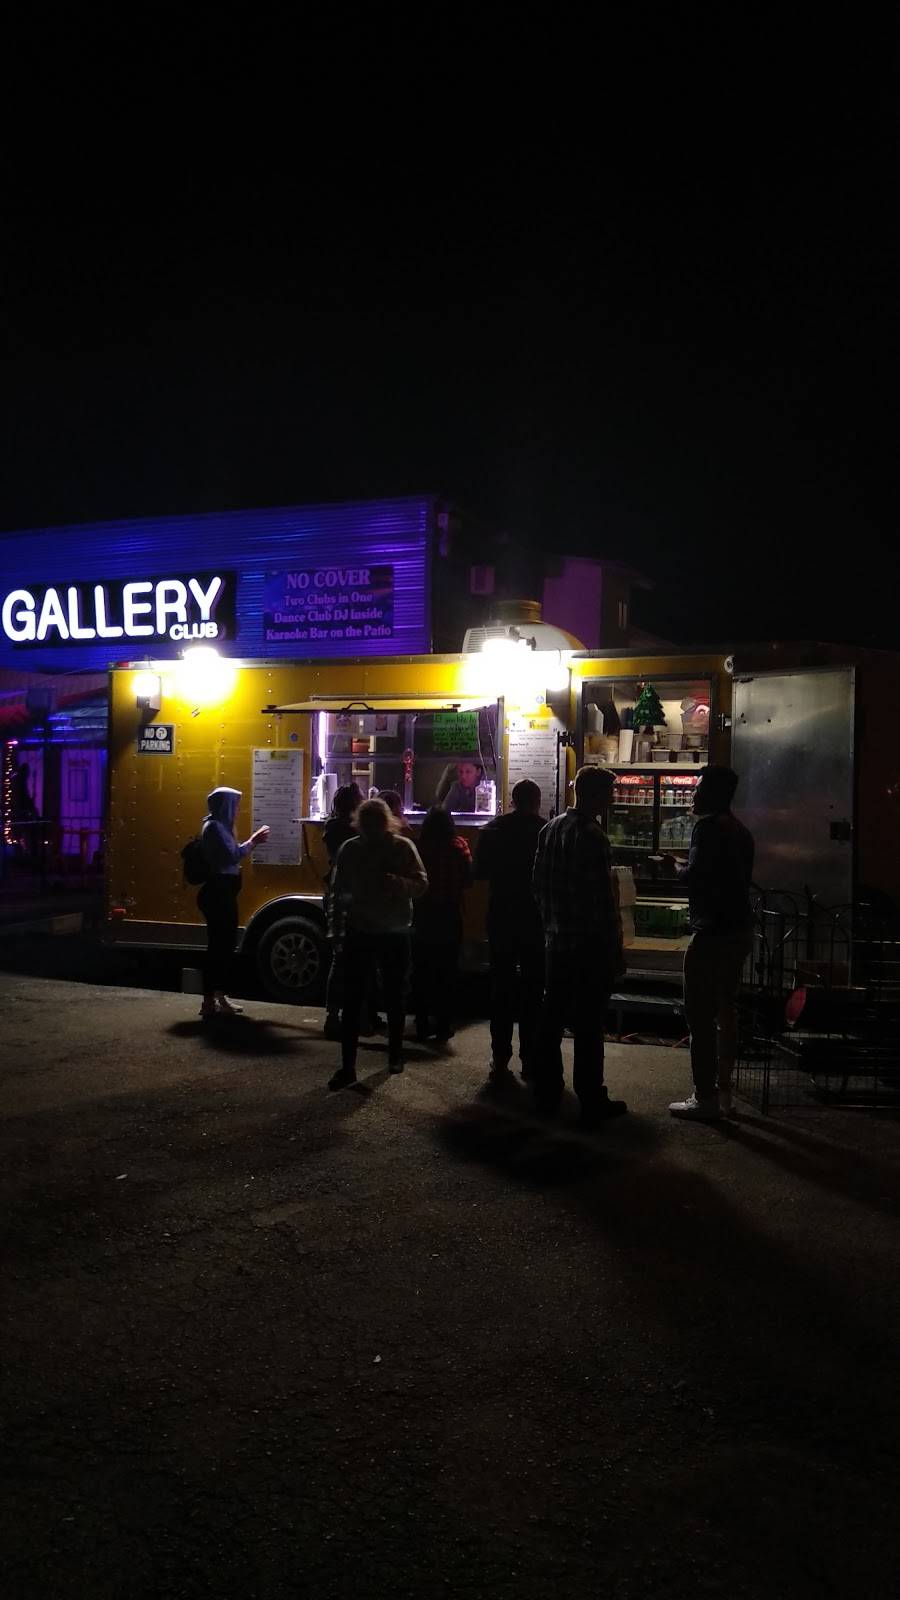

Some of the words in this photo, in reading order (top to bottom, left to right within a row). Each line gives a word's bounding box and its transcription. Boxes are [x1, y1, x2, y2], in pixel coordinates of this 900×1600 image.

[286, 573, 310, 588] NO
[314, 569, 371, 588] COVER
[285, 595, 305, 606] Two
[307, 593, 336, 605] Clubs
[338, 593, 349, 603] in
[351, 591, 373, 602] One
[1, 576, 222, 641] GALLERY
[274, 612, 305, 623] Dance
[307, 610, 331, 622] Club
[334, 609, 348, 621] DJ
[351, 608, 383, 620] Inside
[170, 622, 218, 640] CLUB
[266, 629, 307, 640] Karaoke
[310, 627, 328, 639] Bar
[330, 629, 343, 638] on
[345, 626, 361, 637] the
[364, 624, 391, 636] Patio
[144, 728, 155, 738] NO
[140, 740, 171, 751] PARKING
